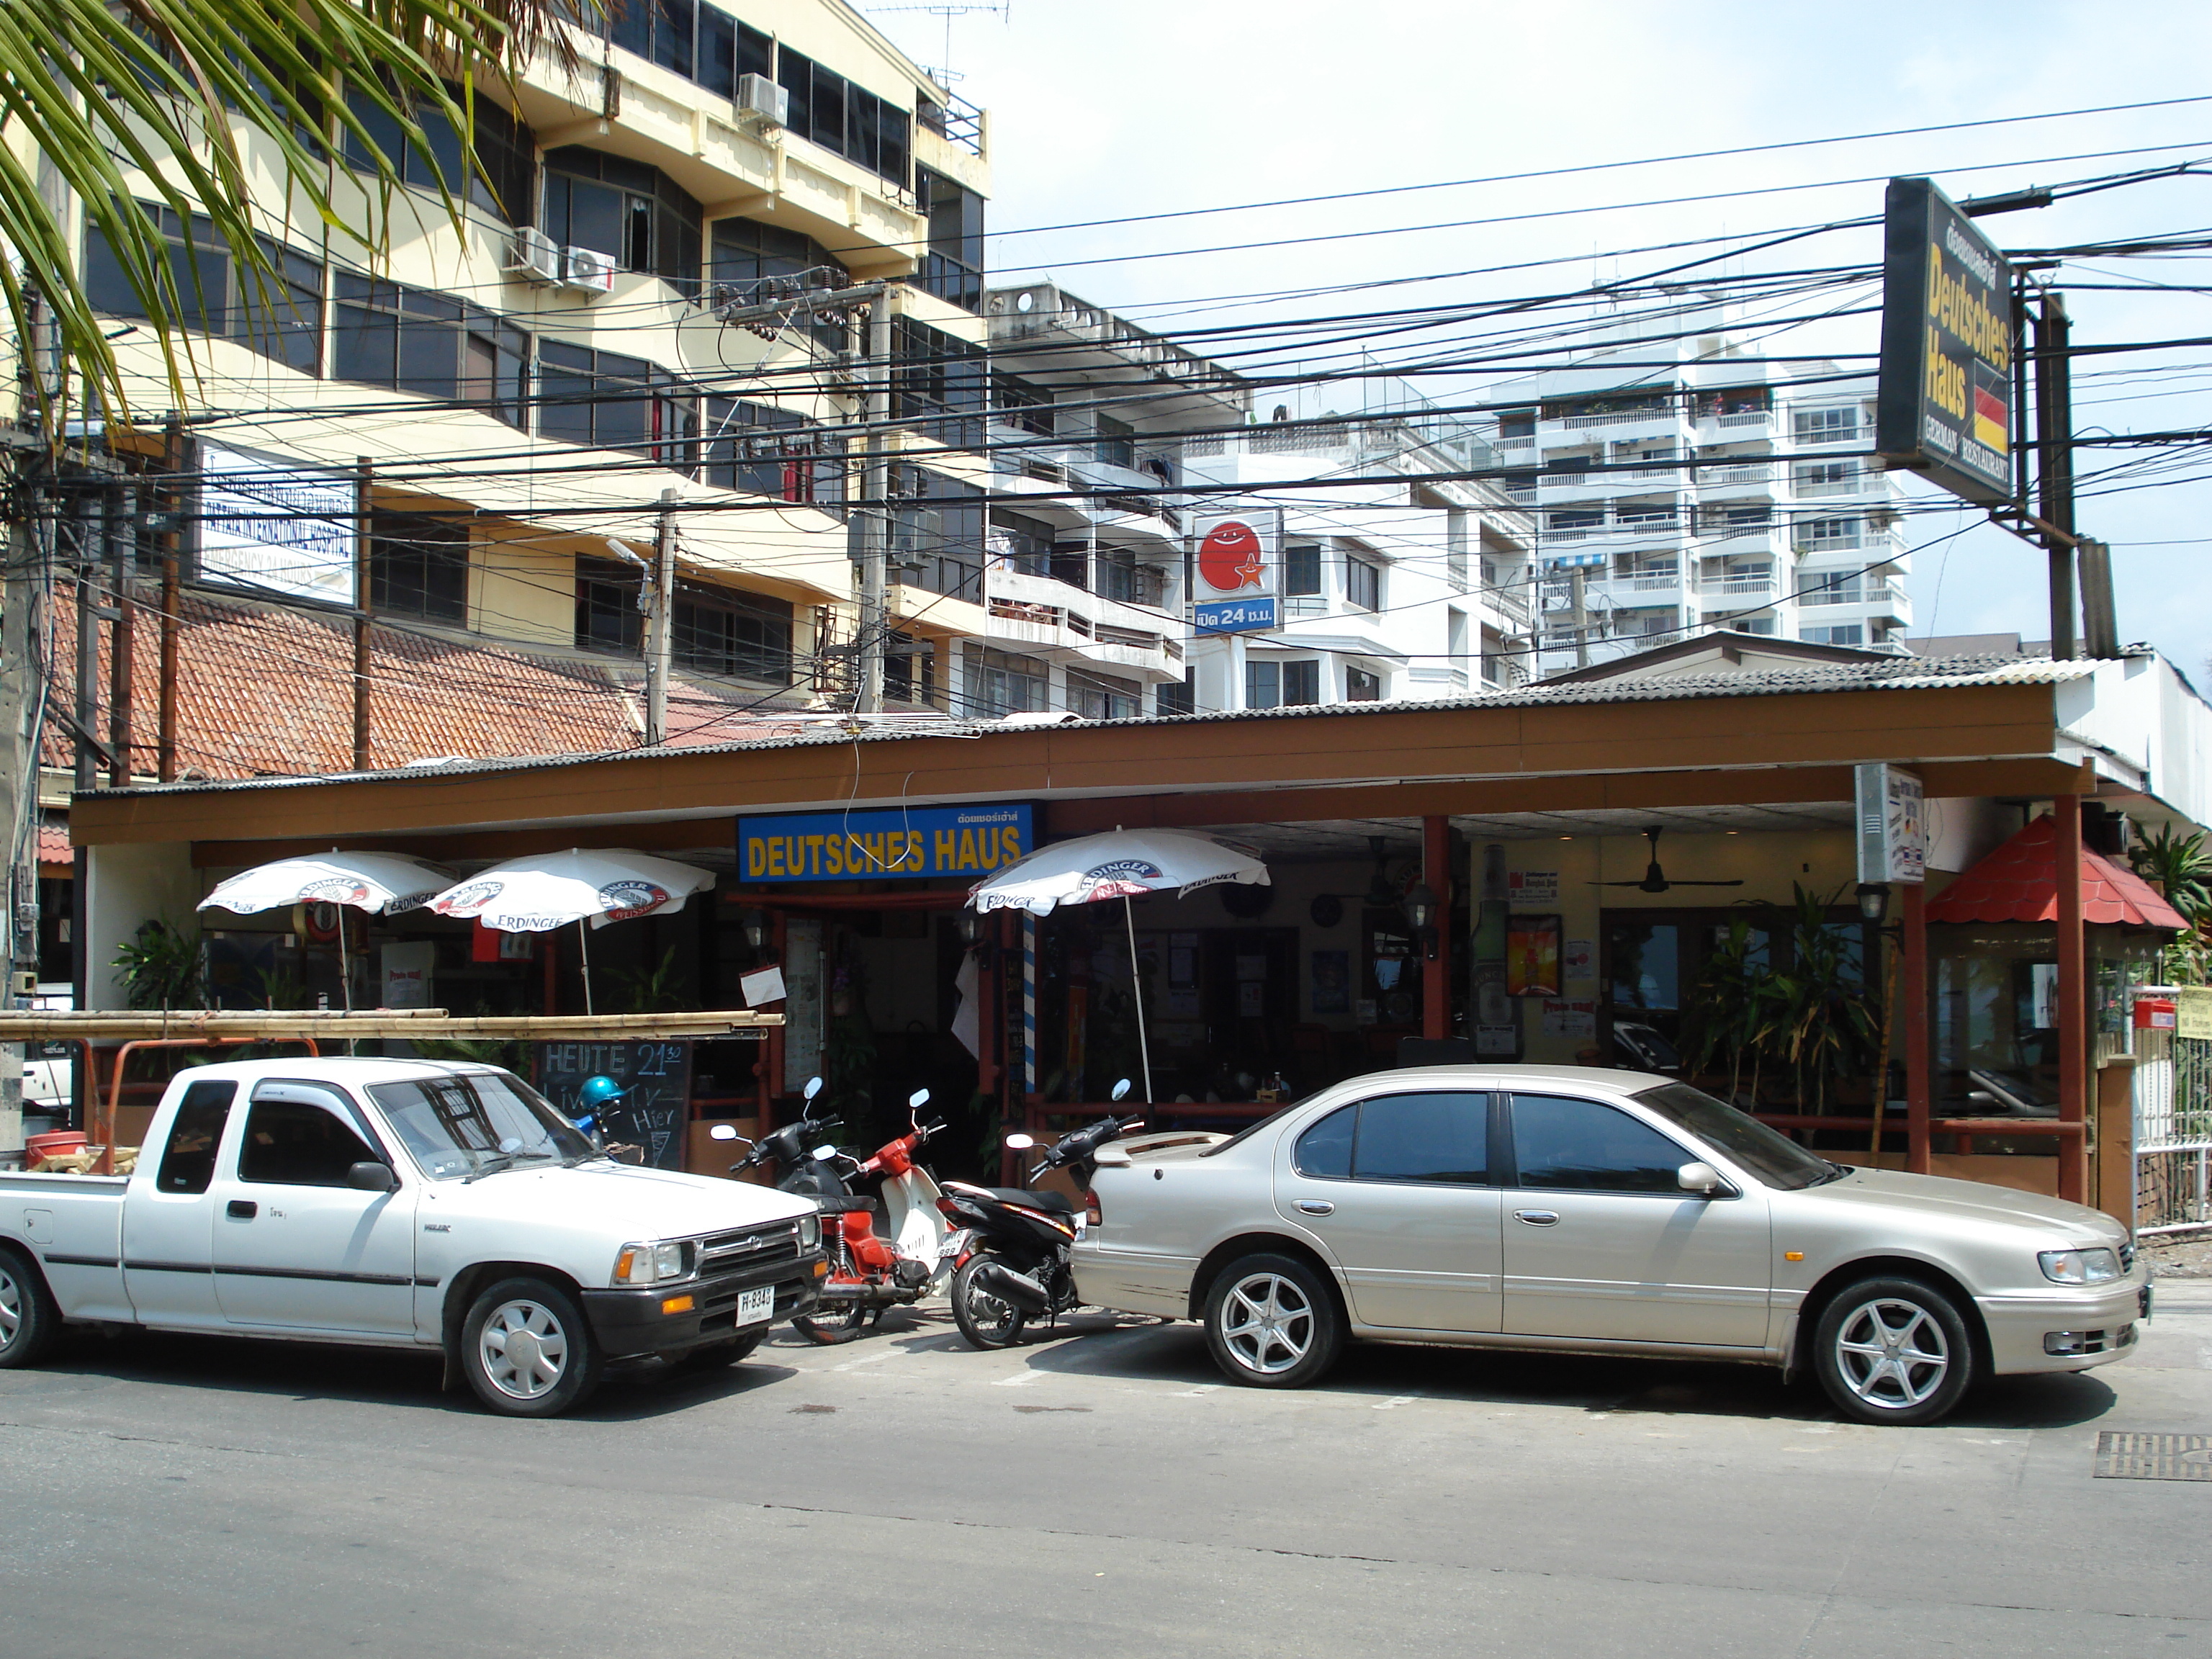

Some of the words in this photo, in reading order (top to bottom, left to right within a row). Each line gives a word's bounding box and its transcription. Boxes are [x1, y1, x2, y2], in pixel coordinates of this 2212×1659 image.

[1929, 243, 2008, 372] Deutsches
[1926, 325, 1966, 421] Haus
[1926, 414, 1957, 454] GERMAN
[1962, 436, 2008, 482] RESTAURANT
[206, 501, 240, 533] PATTAYA
[243, 507, 307, 550] INTERNATIONAL
[310, 522, 349, 558] HOSPITAL
[204, 544, 264, 580] EMERGENCY
[266, 555, 277, 582] 24
[280, 557, 312, 586] HOURS
[1197, 613, 1218, 626] เปิด
[1221, 608, 1245, 624] 24
[748, 830, 924, 876] DEUTSCHES
[935, 826, 1021, 871] HAUS
[298, 878, 359, 899] ERDINGER
[1082, 862, 1149, 889] ERDINGER
[600, 882, 648, 907] ERDINGER
[546, 1044, 625, 1073] HEUTE
[632, 1110, 674, 1133] Hier
[938, 1248, 956, 1257] 999
